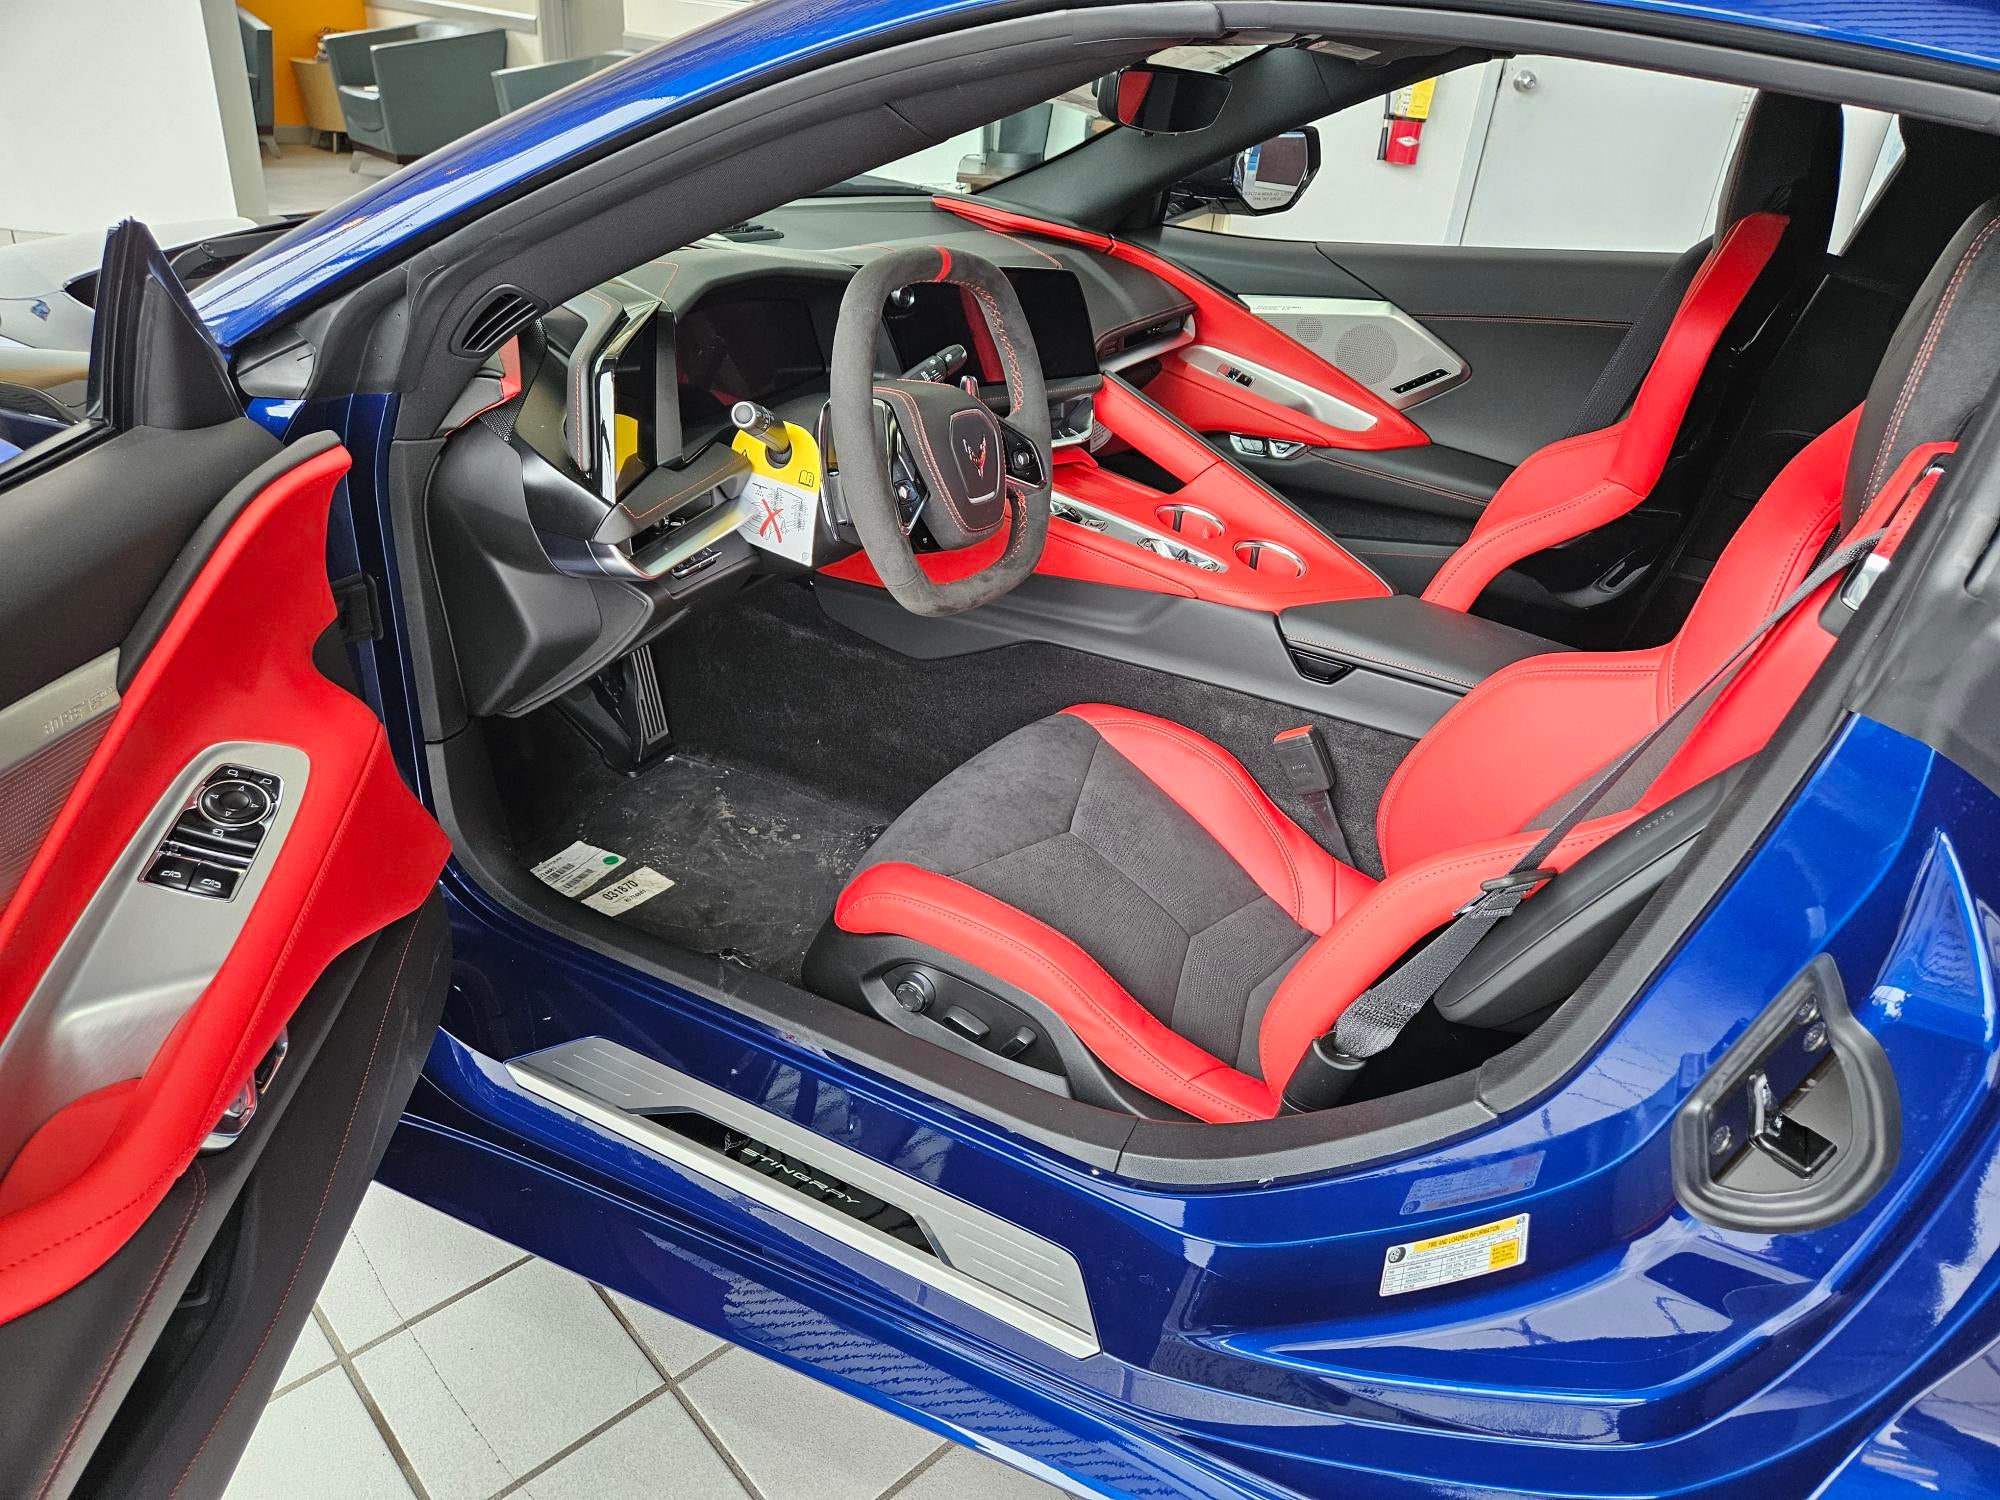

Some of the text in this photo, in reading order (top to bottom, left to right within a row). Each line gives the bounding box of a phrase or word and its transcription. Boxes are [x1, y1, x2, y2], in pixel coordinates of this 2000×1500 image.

[602, 880, 638, 901] 031870
[741, 1148, 861, 1204] STINGRAY
[1438, 1237, 1448, 1246] AND
[1448, 1231, 1469, 1243] LOADING
